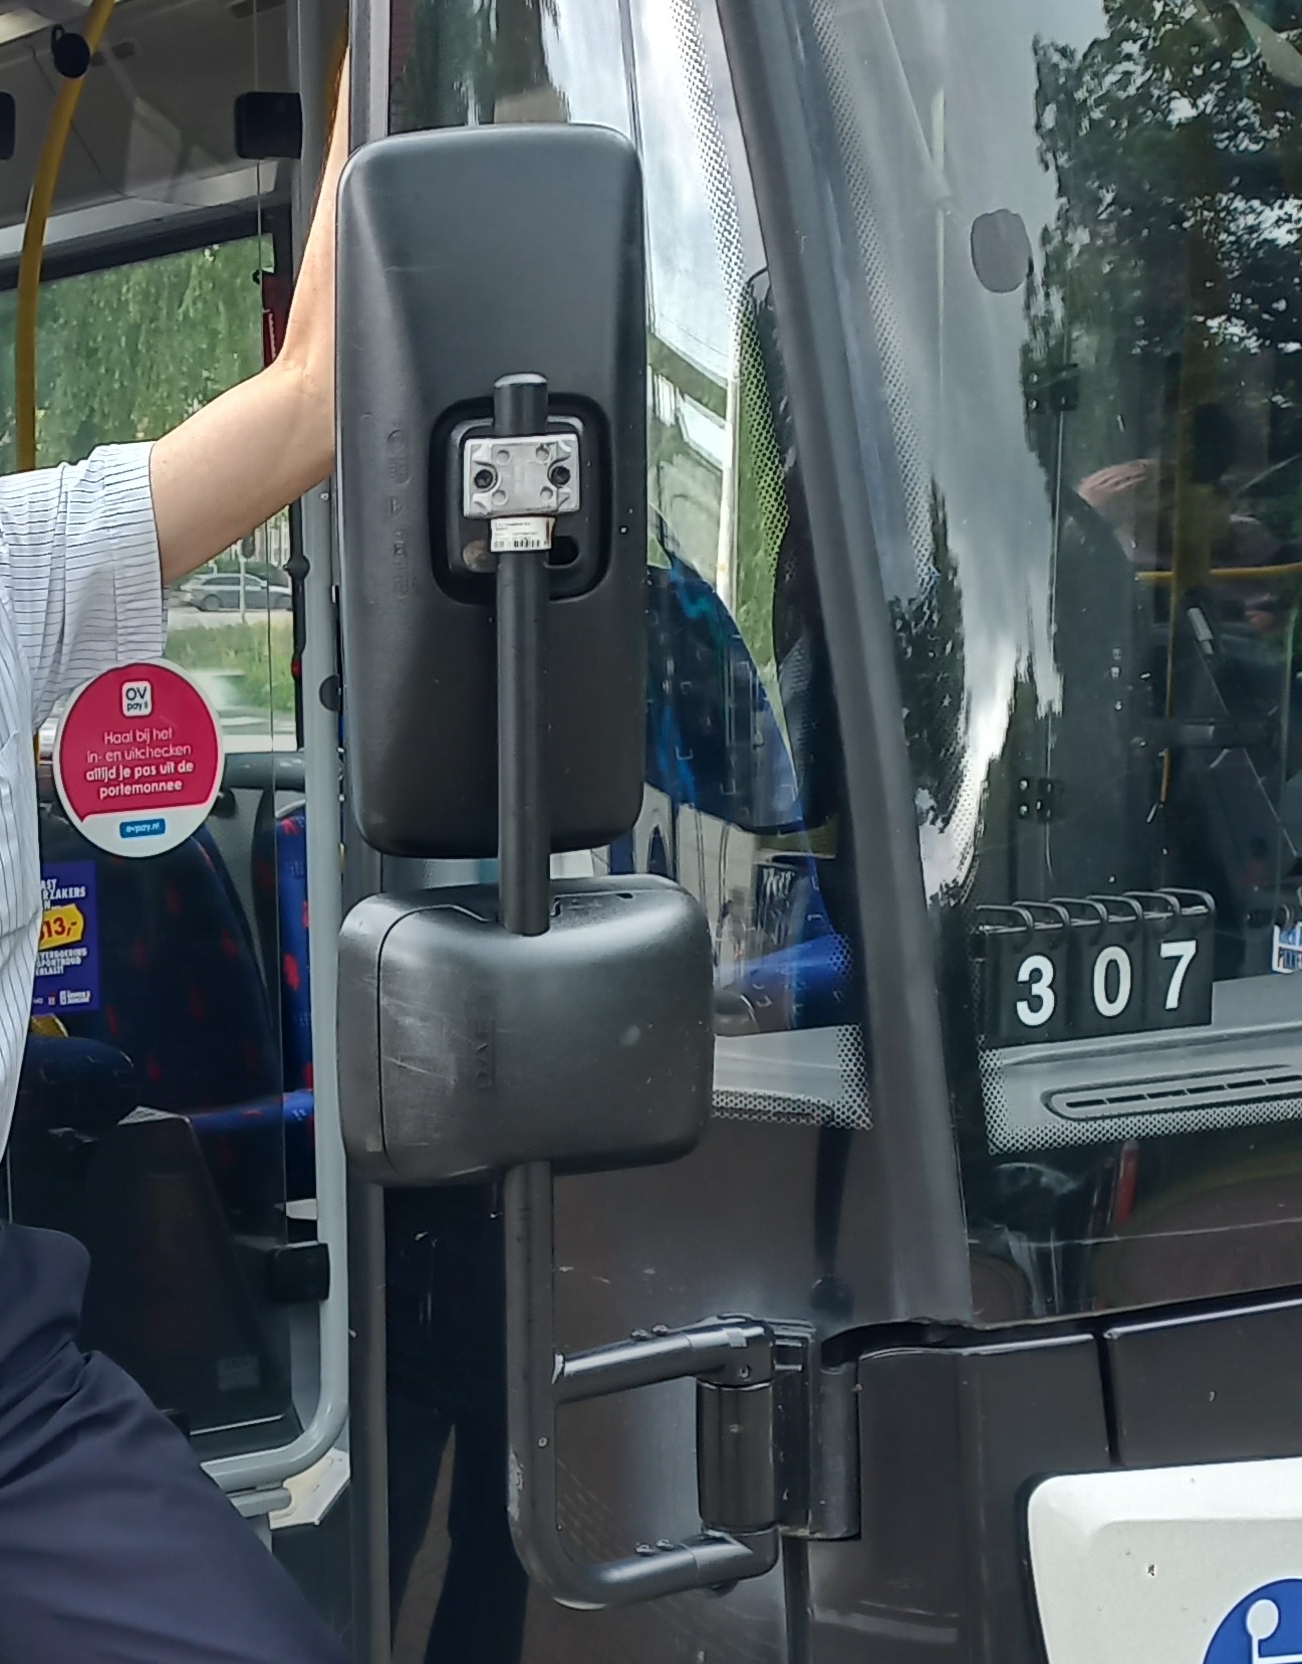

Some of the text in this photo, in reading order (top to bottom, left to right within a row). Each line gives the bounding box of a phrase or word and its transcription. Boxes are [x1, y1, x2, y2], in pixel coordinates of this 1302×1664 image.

[125, 686, 147, 701] OV
[126, 702, 143, 712] pay
[103, 727, 173, 745] Haal bij het
[86, 744, 192, 763] in- en uitchecken
[85, 759, 194, 782] altijd je pas uit de
[99, 780, 183, 800] portemonnee
[42, 886, 86, 900] RZAKERS
[40, 916, 78, 940] 13,-
[1016, 940, 1197, 1028] 307
